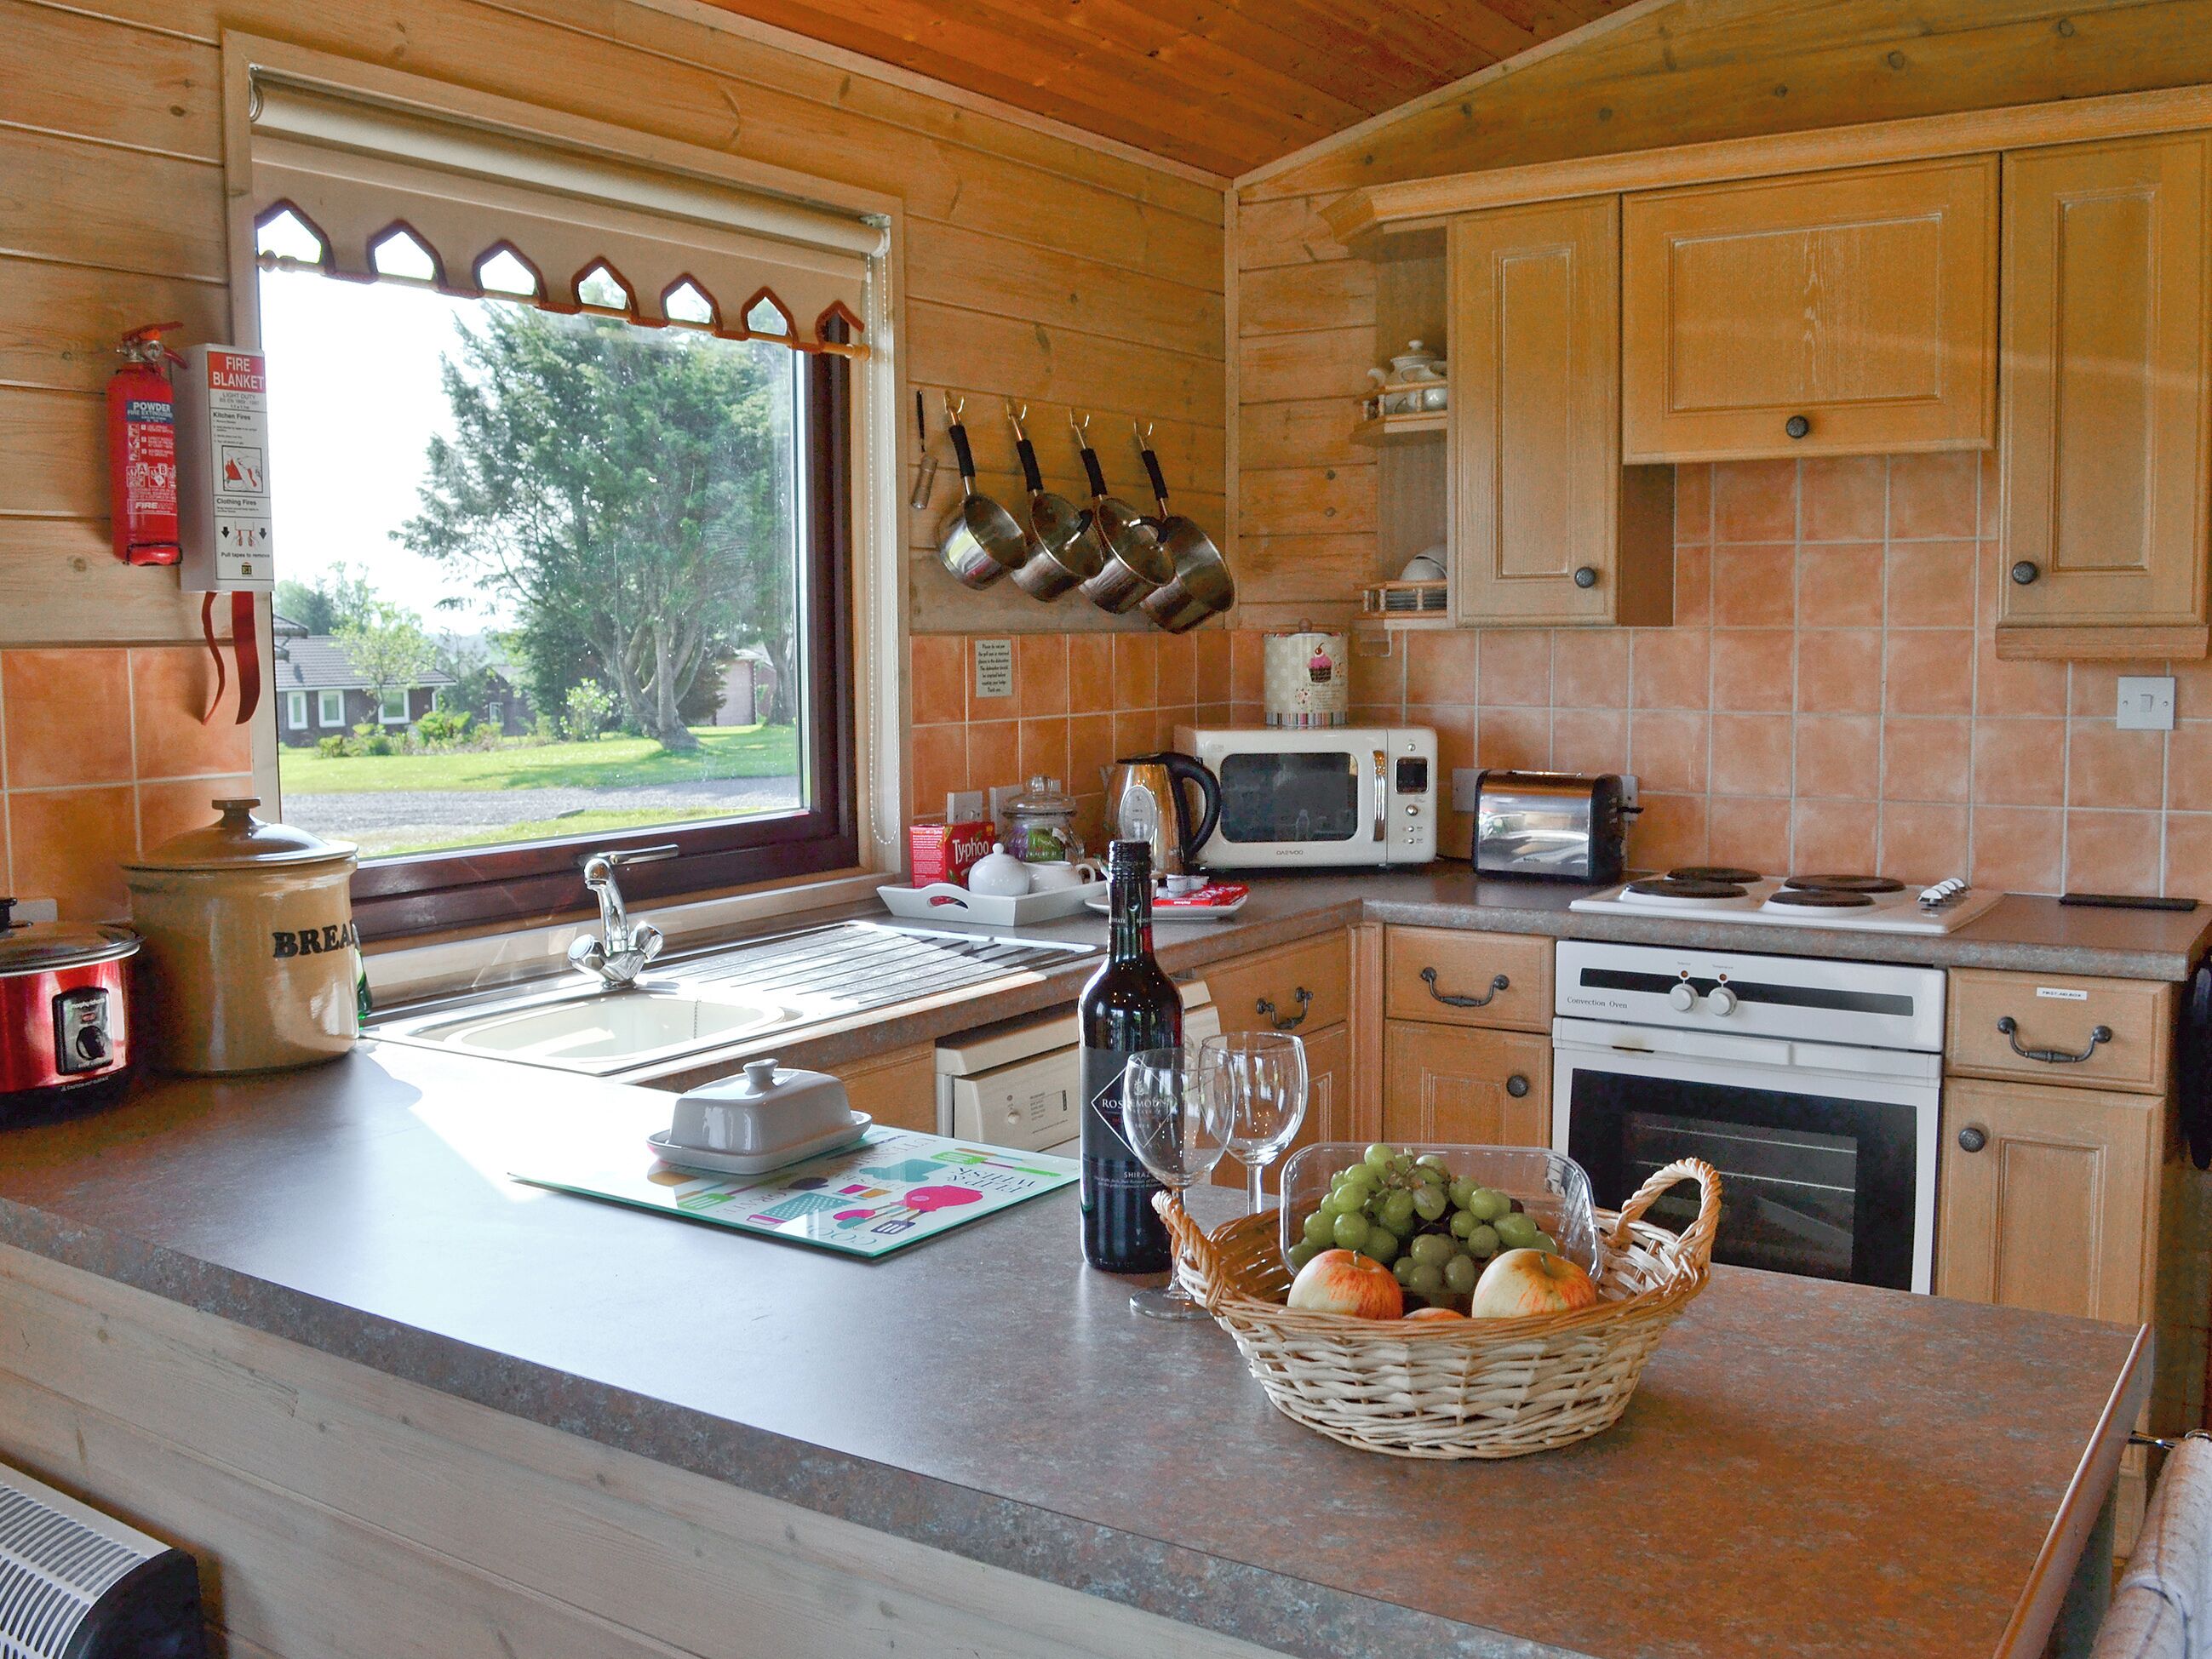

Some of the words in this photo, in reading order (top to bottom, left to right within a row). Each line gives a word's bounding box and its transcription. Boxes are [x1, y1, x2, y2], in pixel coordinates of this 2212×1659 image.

[226, 357, 251, 372] FIRE
[212, 371, 265, 390] BLANKET
[133, 402, 171, 413] POWDER
[952, 837, 989, 865] Typhoo
[1567, 996, 1606, 1007] Convection
[1608, 1000, 1628, 1009] Oven
